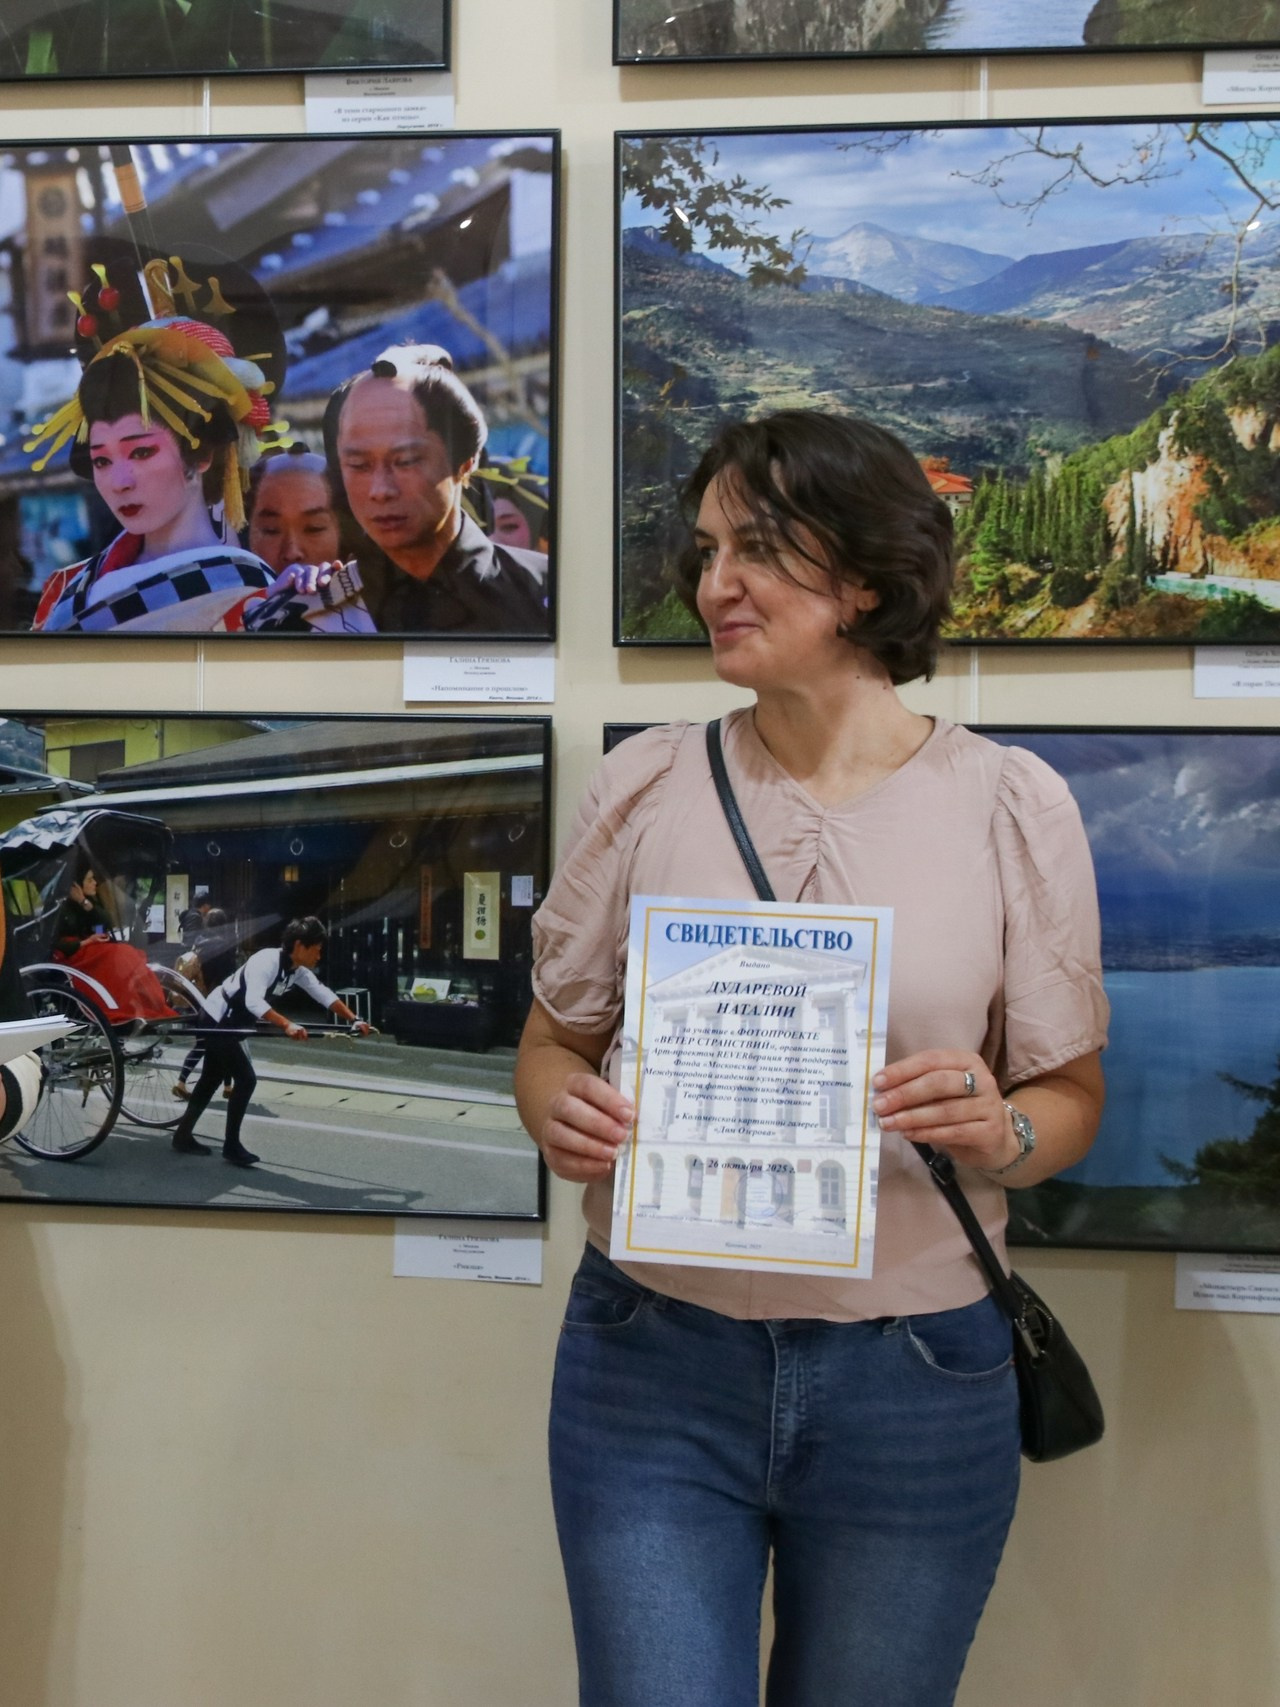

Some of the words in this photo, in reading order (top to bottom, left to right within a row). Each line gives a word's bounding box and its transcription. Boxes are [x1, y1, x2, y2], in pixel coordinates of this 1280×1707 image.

[449, 656, 477, 664] ГАЛИНА
[665, 922, 853, 951] СВИДЕТЕЛЬСТВО
[739, 960, 771, 970] Выдано
[706, 981, 807, 998] ДУДАРЕВОЙ
[716, 1003, 796, 1018] НАТАЛИИ
[692, 1028, 728, 1036] участие
[737, 1028, 820, 1040] ФОТОПРОЕКТЕ
[654, 1036, 696, 1046] «ВЕТЕР
[697, 1038, 778, 1050] СТРАНСТВИЙ»,
[779, 1045, 848, 1055] организованном
[652, 1048, 714, 1058] Арт-проектом
[716, 1050, 782, 1062] REVERберация
[784, 1056, 800, 1064] при
[802, 1056, 849, 1066] поддержке
[674, 1058, 701, 1068] Фонда
[703, 1060, 758, 1071] «Московские
[758, 1064, 826, 1076] энциклопедии»,
[644, 1068, 713, 1080] Международной
[714, 1073, 754, 1082] академии
[756, 1075, 798, 1086] культуры
[808, 1079, 854, 1088] искусства,
[677, 1081, 704, 1090] Союза
[705, 1082, 780, 1095] фотохудожников
[782, 1087, 812, 1096] России
[683, 1092, 732, 1102] Творческого
[760, 1098, 812, 1106] художников
[682, 1112, 736, 1124] Коломенской
[738, 1117, 786, 1127] картинной
[788, 1120, 819, 1128] галерее
[714, 1126, 736, 1134] «Дом
[738, 1127, 777, 1138] Озерова»
[708, 1160, 719, 1169] 26
[721, 1160, 762, 1173] октября
[766, 1162, 788, 1174] 2025
